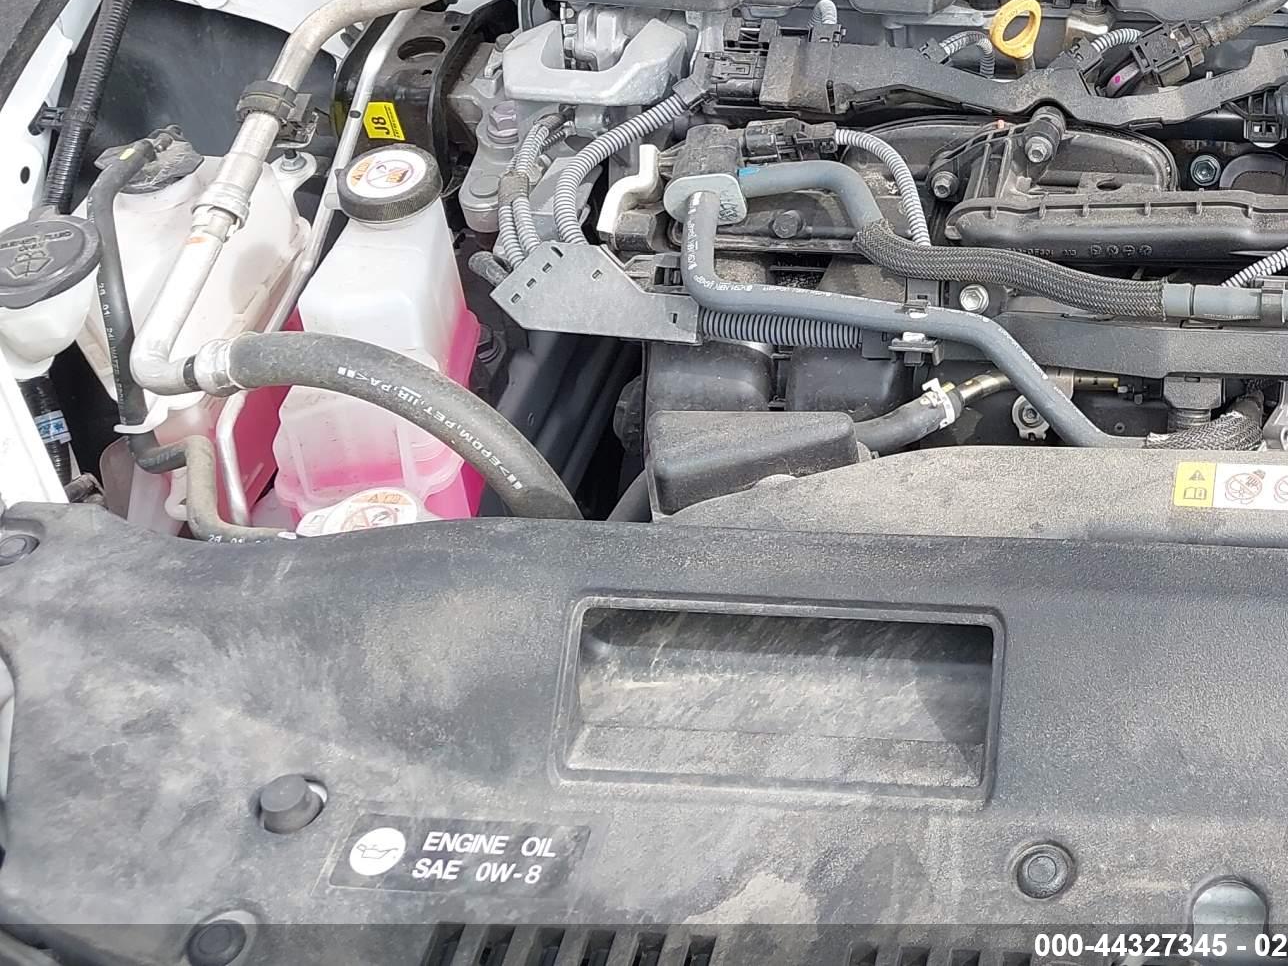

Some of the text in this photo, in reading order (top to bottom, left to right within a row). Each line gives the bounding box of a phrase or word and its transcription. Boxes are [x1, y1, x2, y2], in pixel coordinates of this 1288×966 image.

[371, 116, 391, 136] J8
[422, 831, 557, 858] ENGINE OIL
[411, 857, 543, 884] SAE 0W-8
